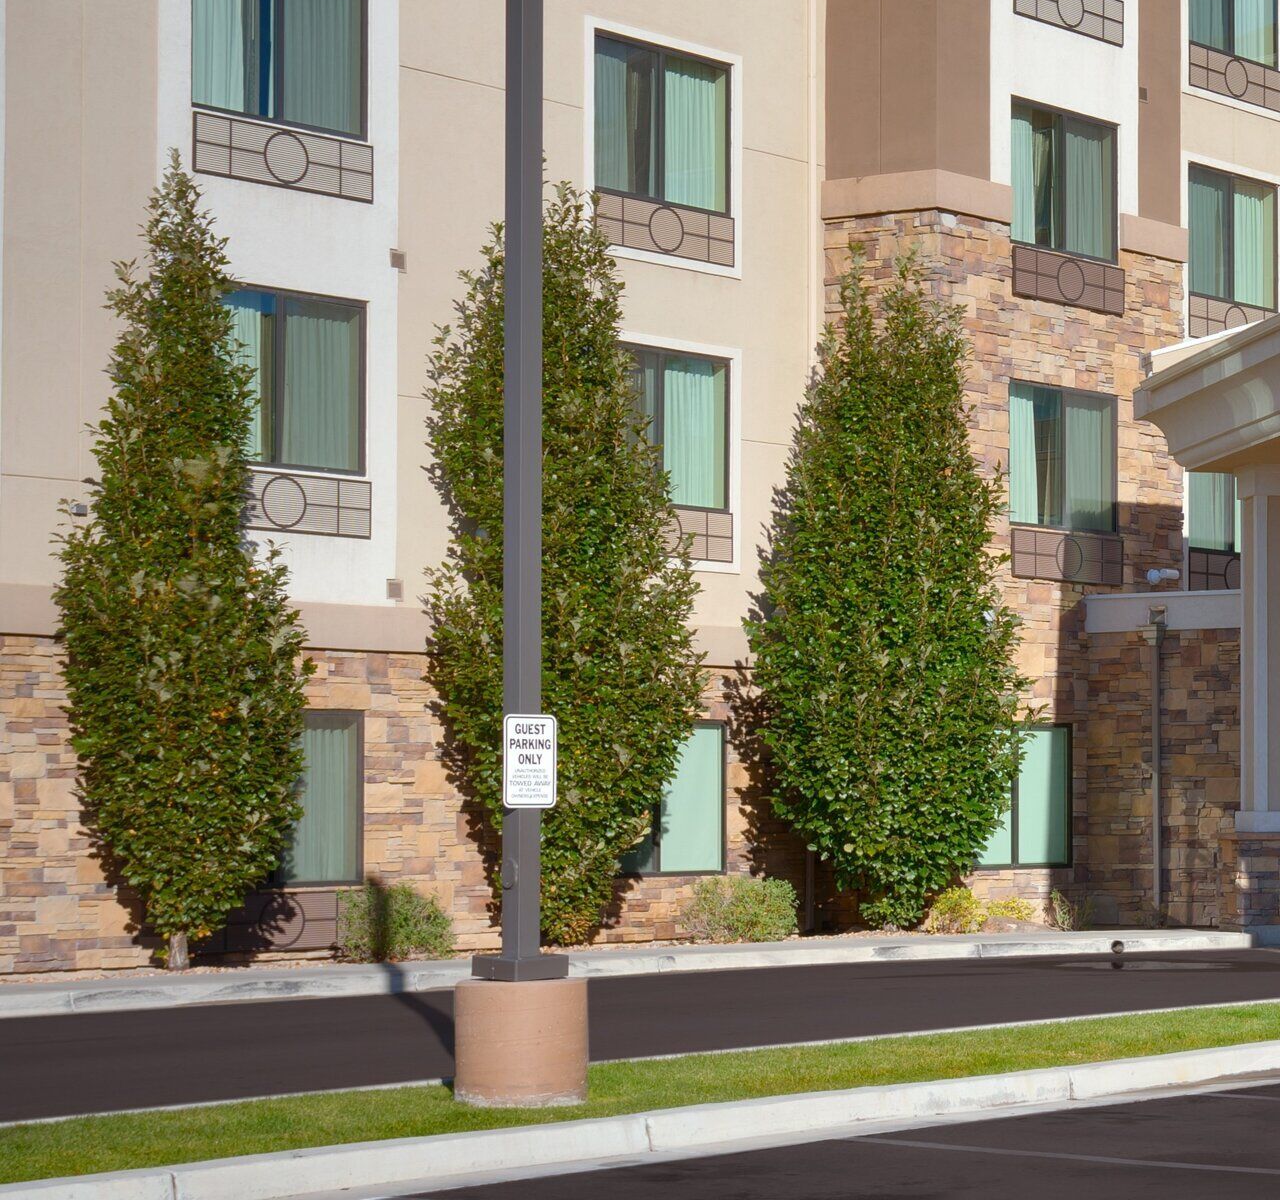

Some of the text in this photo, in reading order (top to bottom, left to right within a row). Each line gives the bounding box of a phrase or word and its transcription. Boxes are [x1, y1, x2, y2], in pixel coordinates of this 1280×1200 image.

[514, 723, 546, 735] GUEST
[509, 738, 551, 750] PARKING
[518, 753, 543, 765] ONLY
